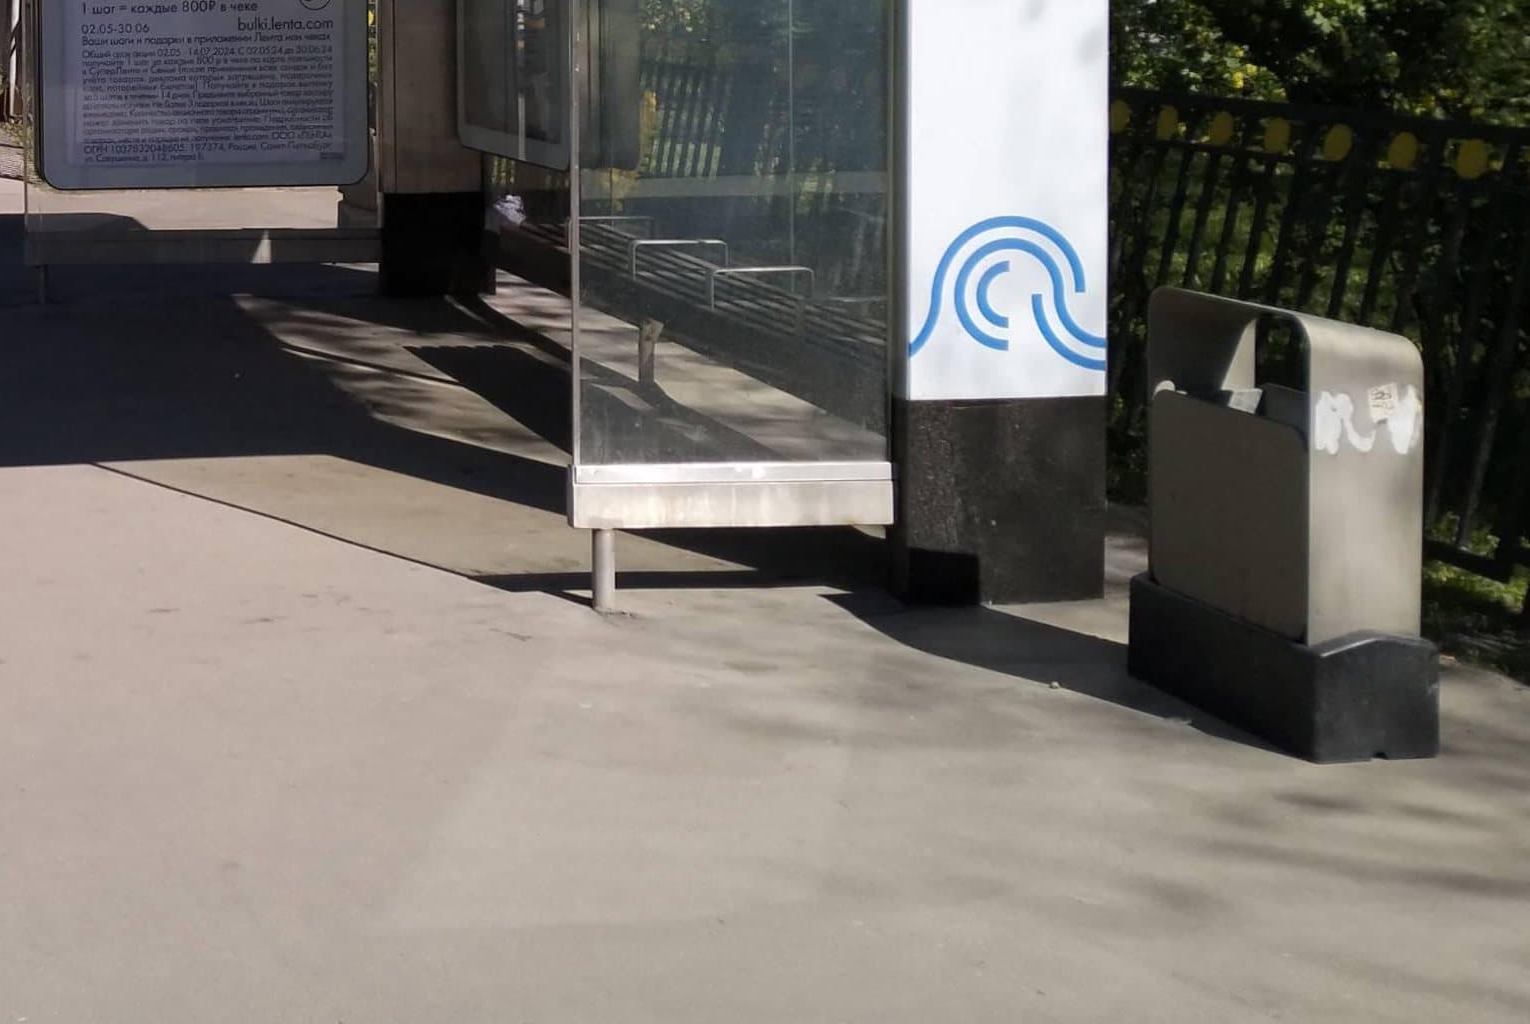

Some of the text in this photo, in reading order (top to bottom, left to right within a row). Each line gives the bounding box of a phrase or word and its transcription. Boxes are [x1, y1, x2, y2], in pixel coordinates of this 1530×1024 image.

[82, 2, 87, 15] 1
[92, 6, 116, 15] шаг
[130, 4, 178, 16] каждые
[220, 3, 227, 12] в
[230, 2, 259, 12] чеке
[237, 16, 334, 31] bulki.lenta.com
